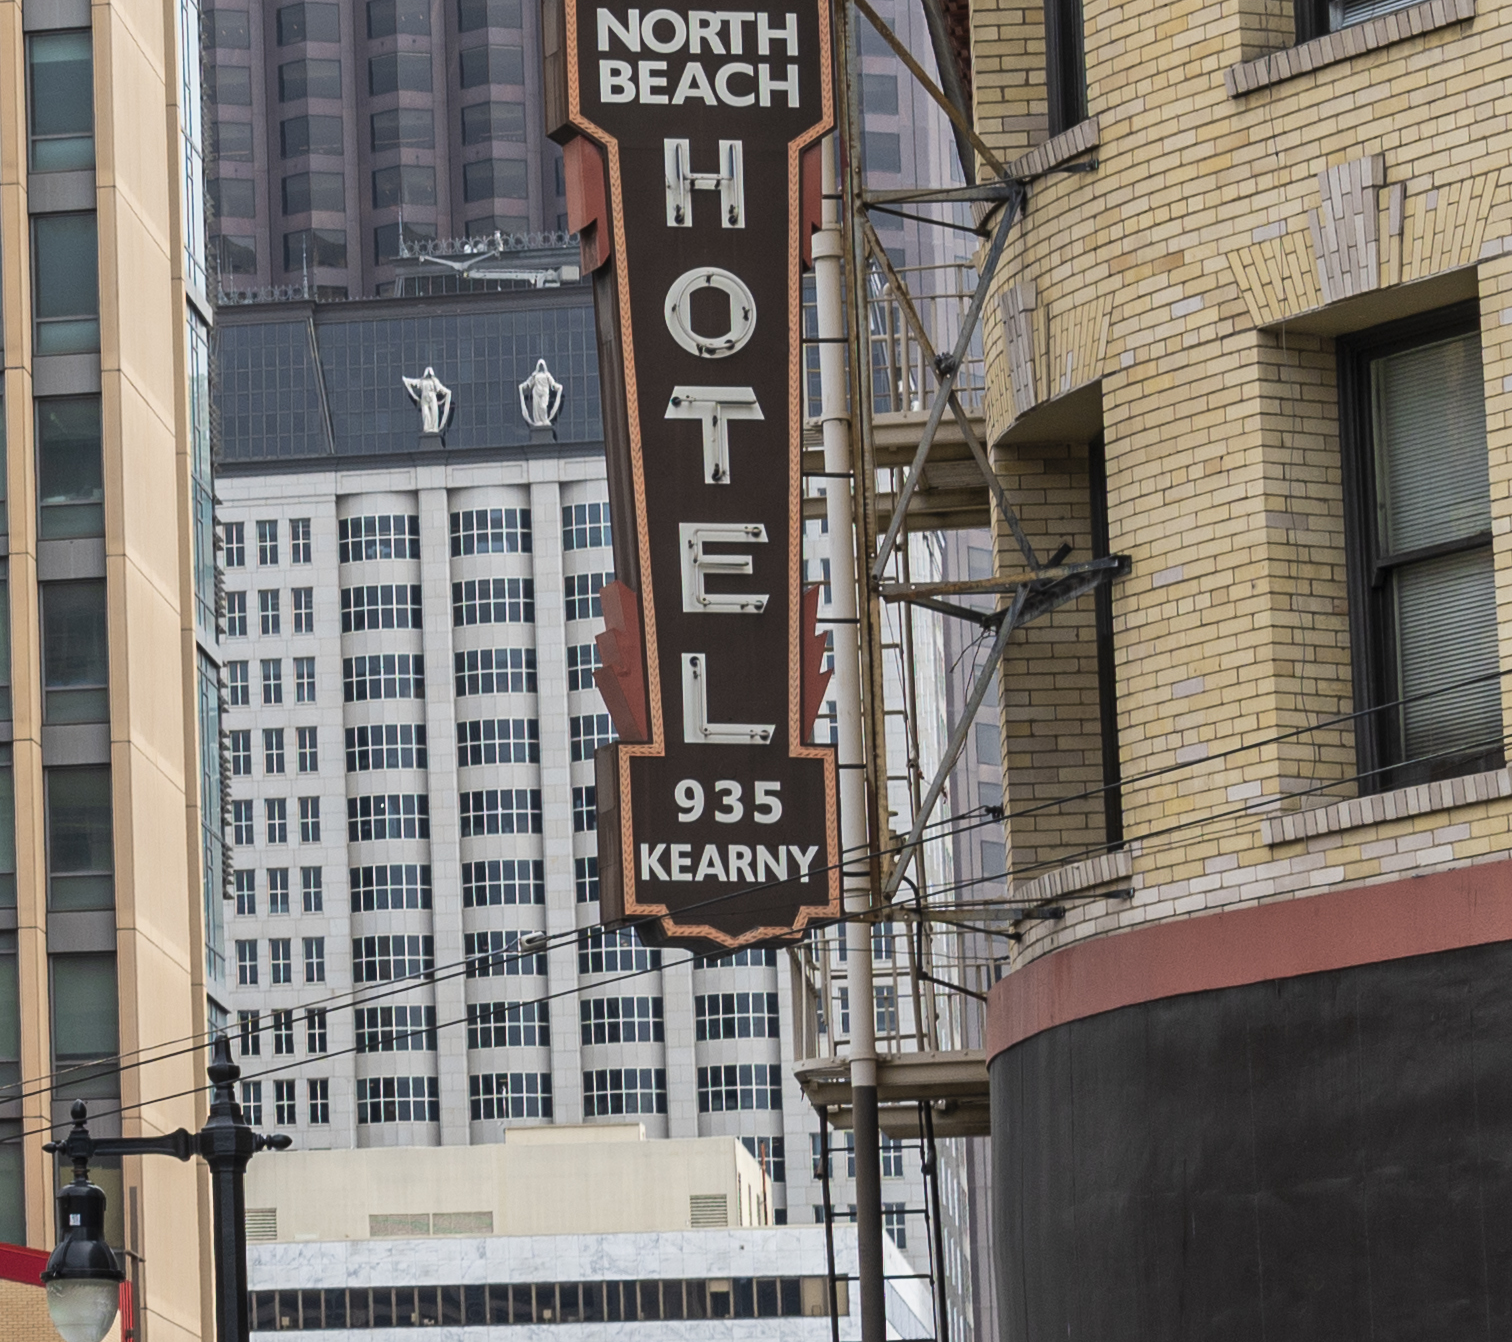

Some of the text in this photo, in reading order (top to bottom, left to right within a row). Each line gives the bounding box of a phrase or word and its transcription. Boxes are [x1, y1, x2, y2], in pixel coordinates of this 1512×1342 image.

[597, 7, 799, 56] NORTH
[599, 59, 800, 108] BEACH
[664, 139, 776, 745] HOTEL
[675, 779, 784, 825] 935
[640, 842, 819, 883] KEARNY
